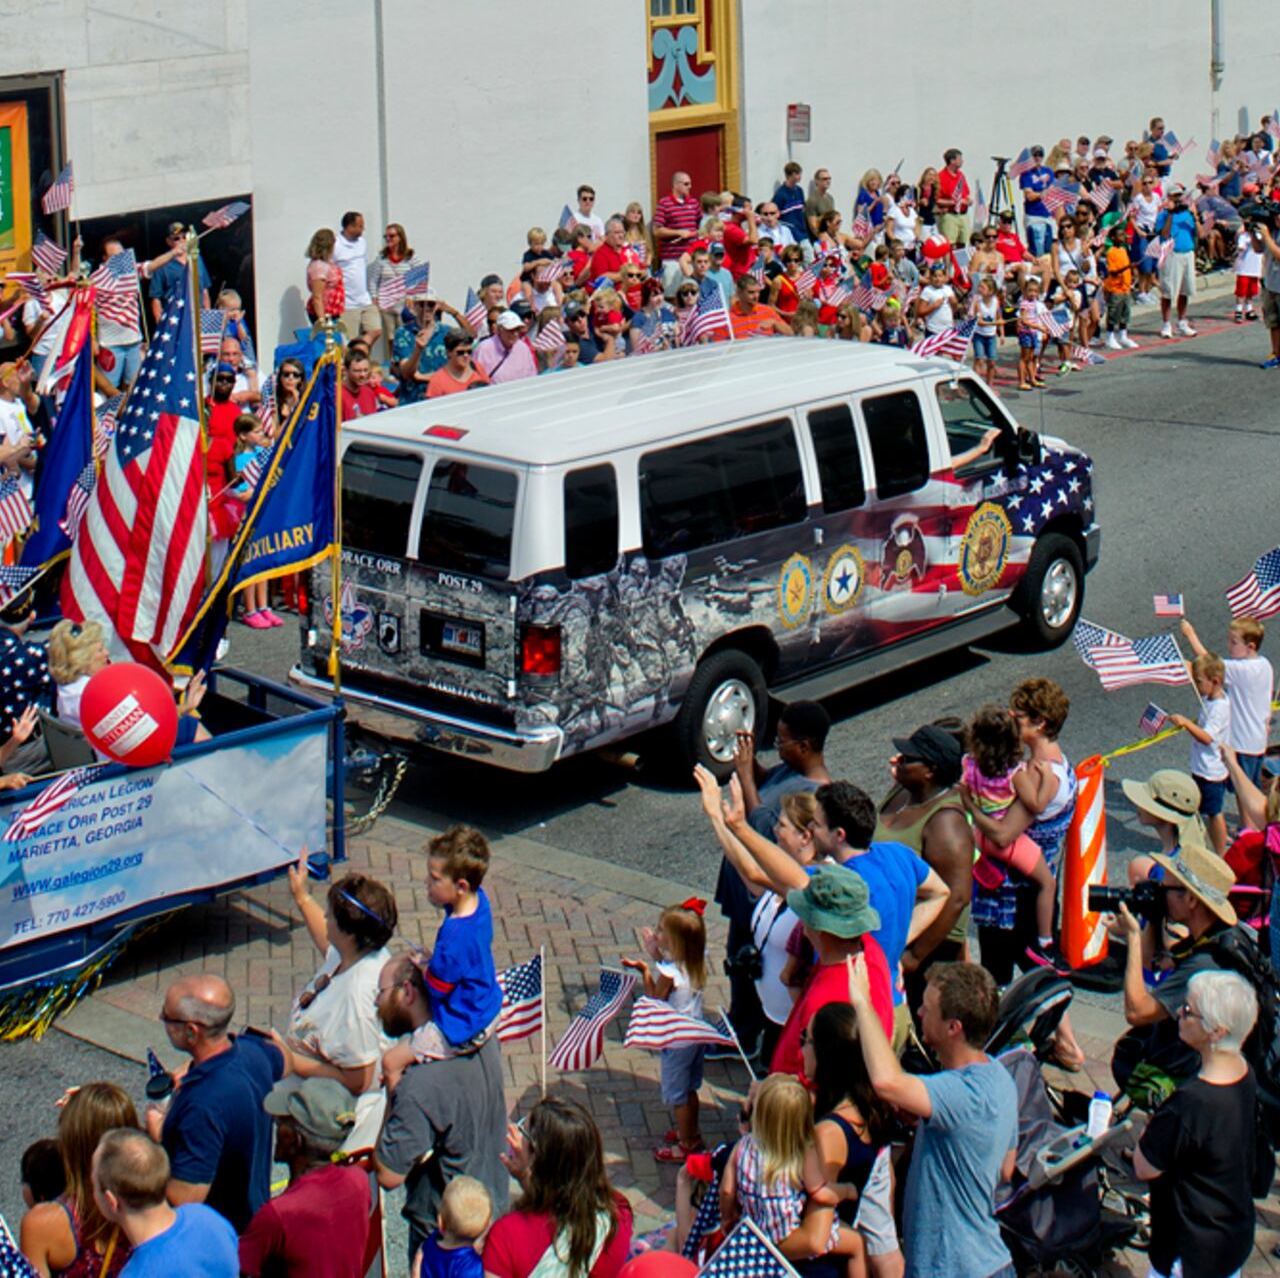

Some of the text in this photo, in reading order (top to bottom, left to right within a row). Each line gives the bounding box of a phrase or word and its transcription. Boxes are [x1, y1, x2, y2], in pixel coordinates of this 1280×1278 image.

[243, 523, 314, 564] UXILIARY
[339, 550, 402, 574] ORACE ORR
[438, 573, 483, 593] POST 29
[60, 777, 154, 813] ERICAN LEGION
[67, 813, 98, 831] ORR
[101, 803, 134, 822] POST
[137, 794, 153, 811] 29
[7, 816, 143, 865] MARIETTA, GEORGIA
[14, 916, 42, 935] TEL:
[47, 909, 69, 926] 770
